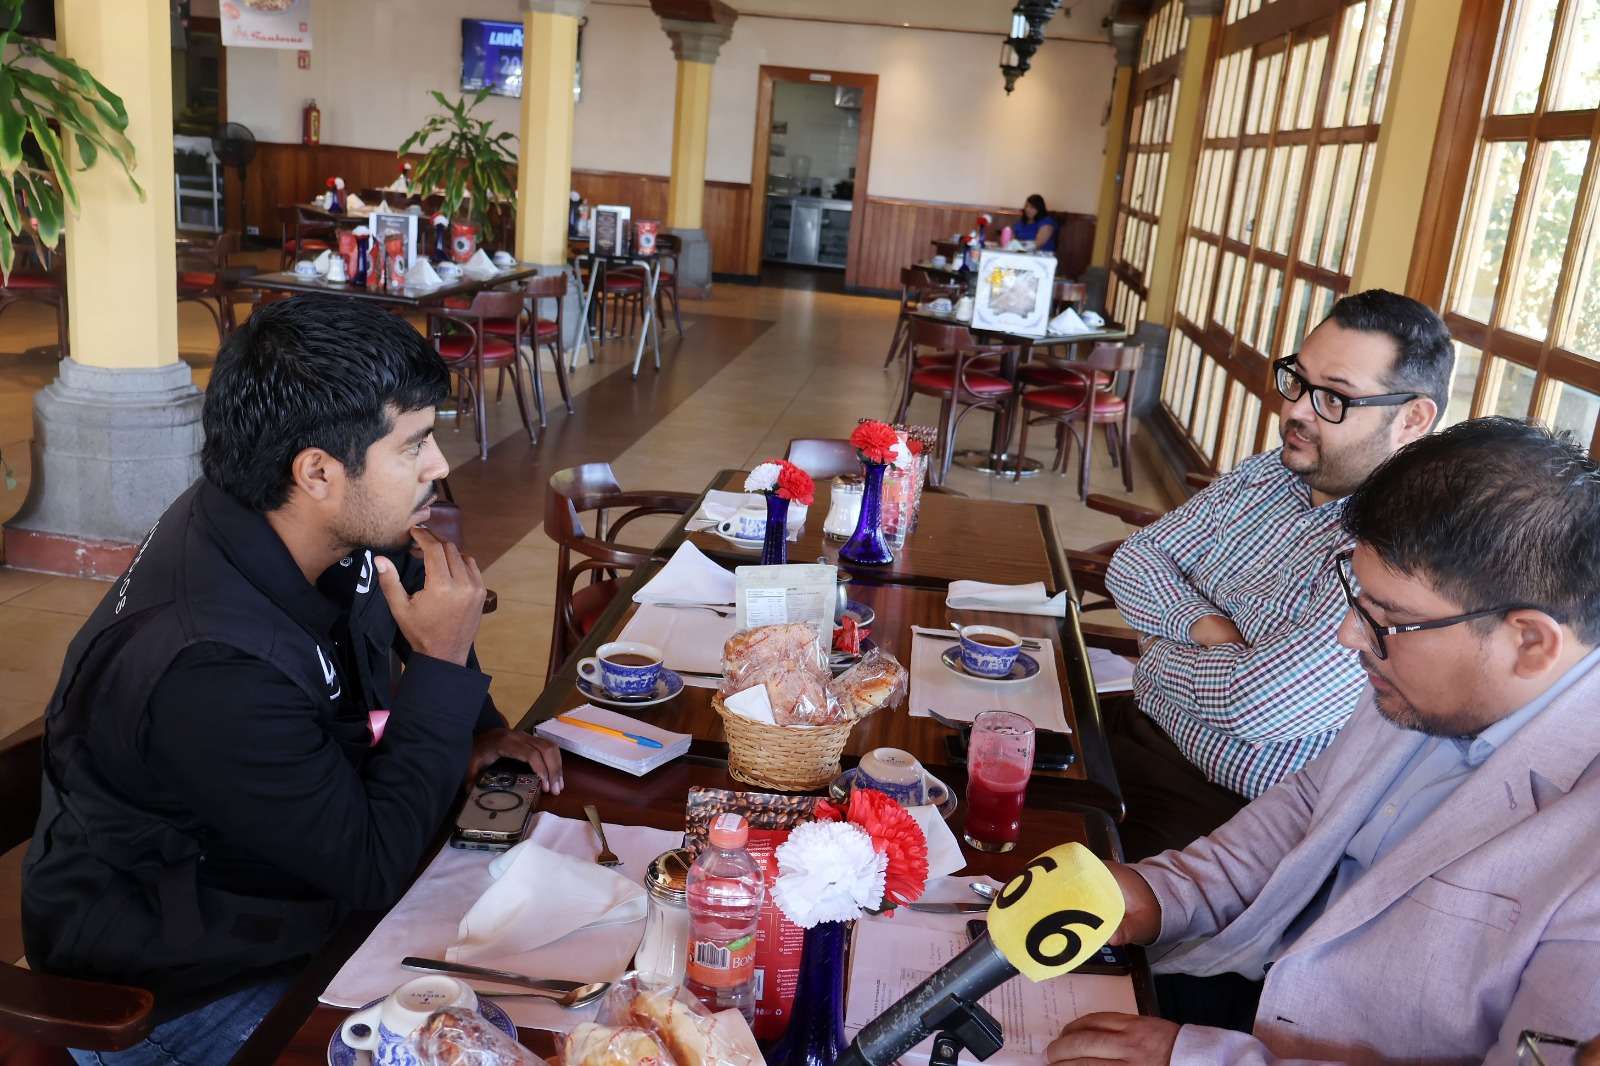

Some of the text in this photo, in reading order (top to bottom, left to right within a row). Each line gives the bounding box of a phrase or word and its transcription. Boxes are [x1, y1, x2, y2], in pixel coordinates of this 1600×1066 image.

[488, 28, 524, 47] LAVA
[996, 856, 1058, 909] 6
[1025, 909, 1104, 967] 6
